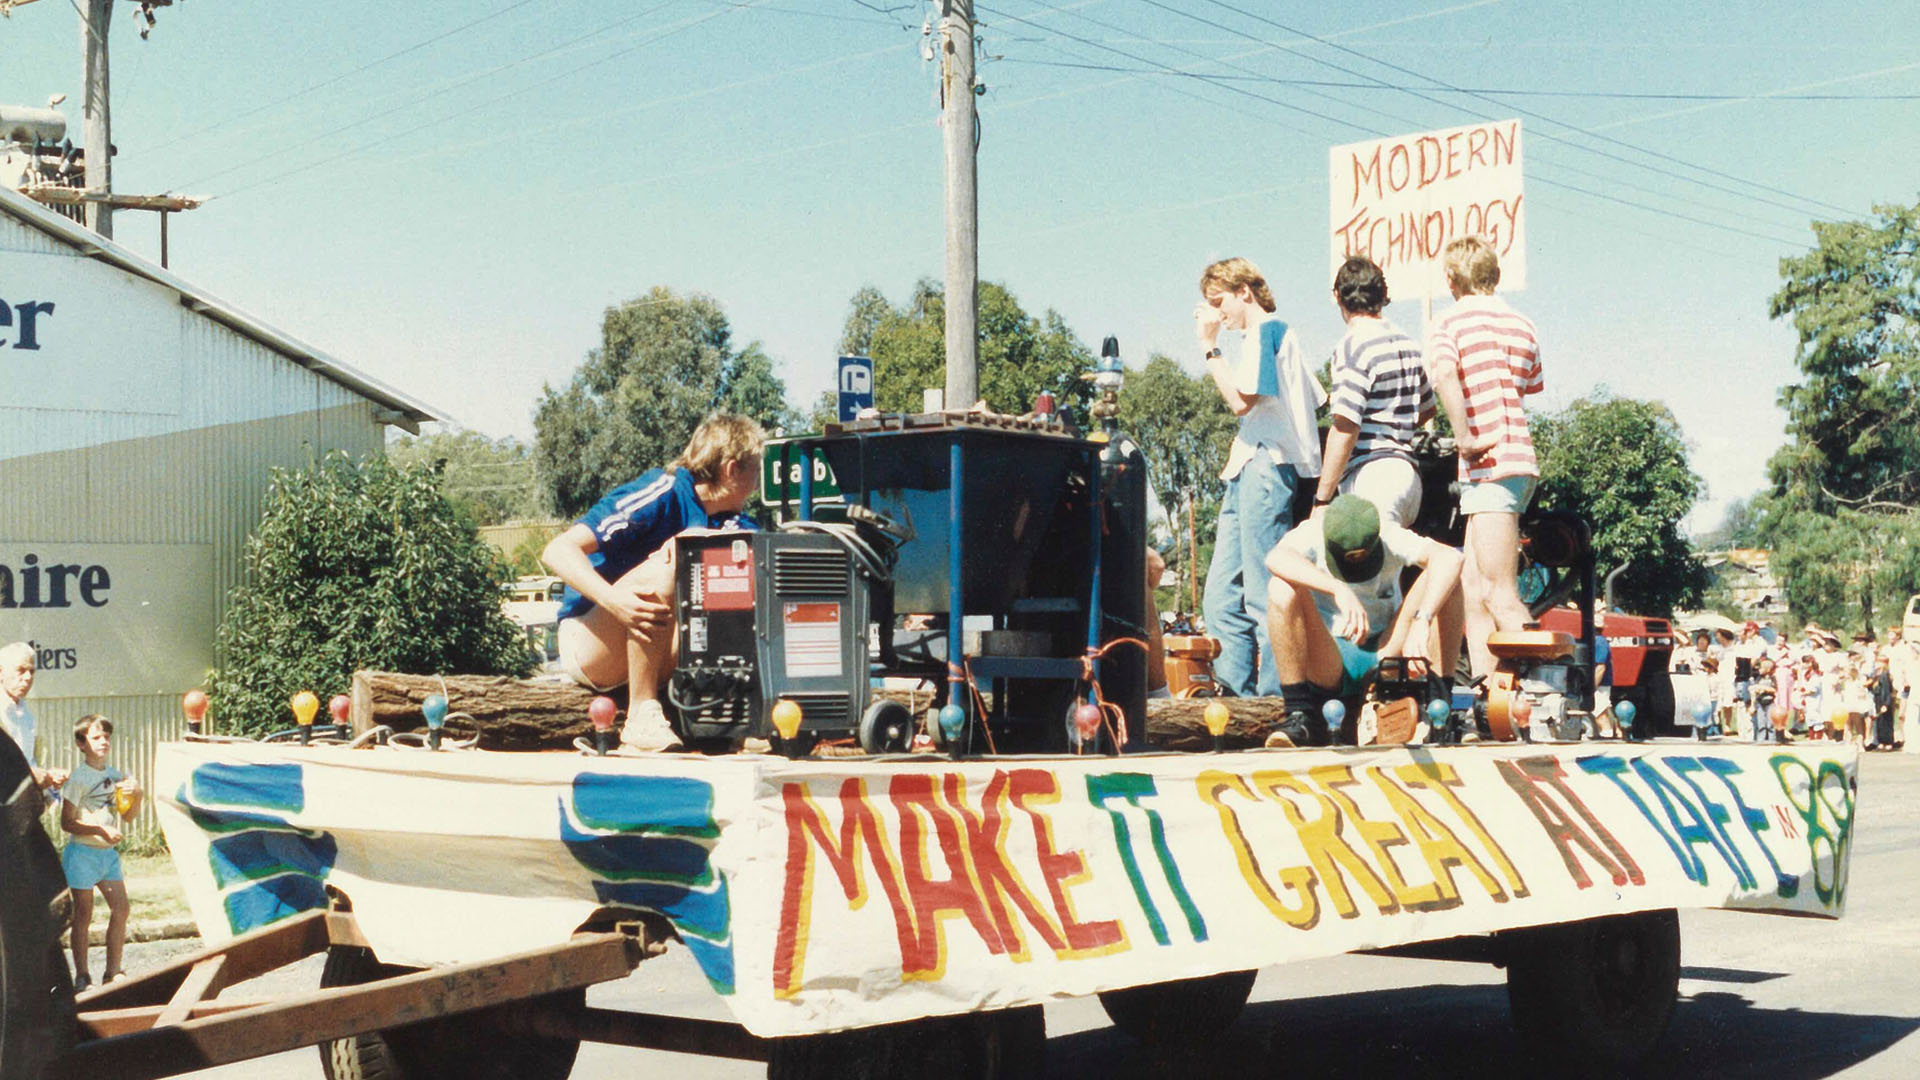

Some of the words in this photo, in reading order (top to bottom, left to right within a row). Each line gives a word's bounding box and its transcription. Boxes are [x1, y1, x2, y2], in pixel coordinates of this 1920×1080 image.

[1352, 122, 1516, 208] MODERN
[28, 640, 77, 670] iers
[774, 768, 1132, 999] MAKE
[1085, 773, 1209, 946] IT
[1195, 762, 1531, 930] GREAT
[1493, 755, 1646, 891] AT
[1575, 756, 1799, 898] TAFE
[1768, 752, 1855, 911] 88
[1772, 805, 1800, 839] IN
